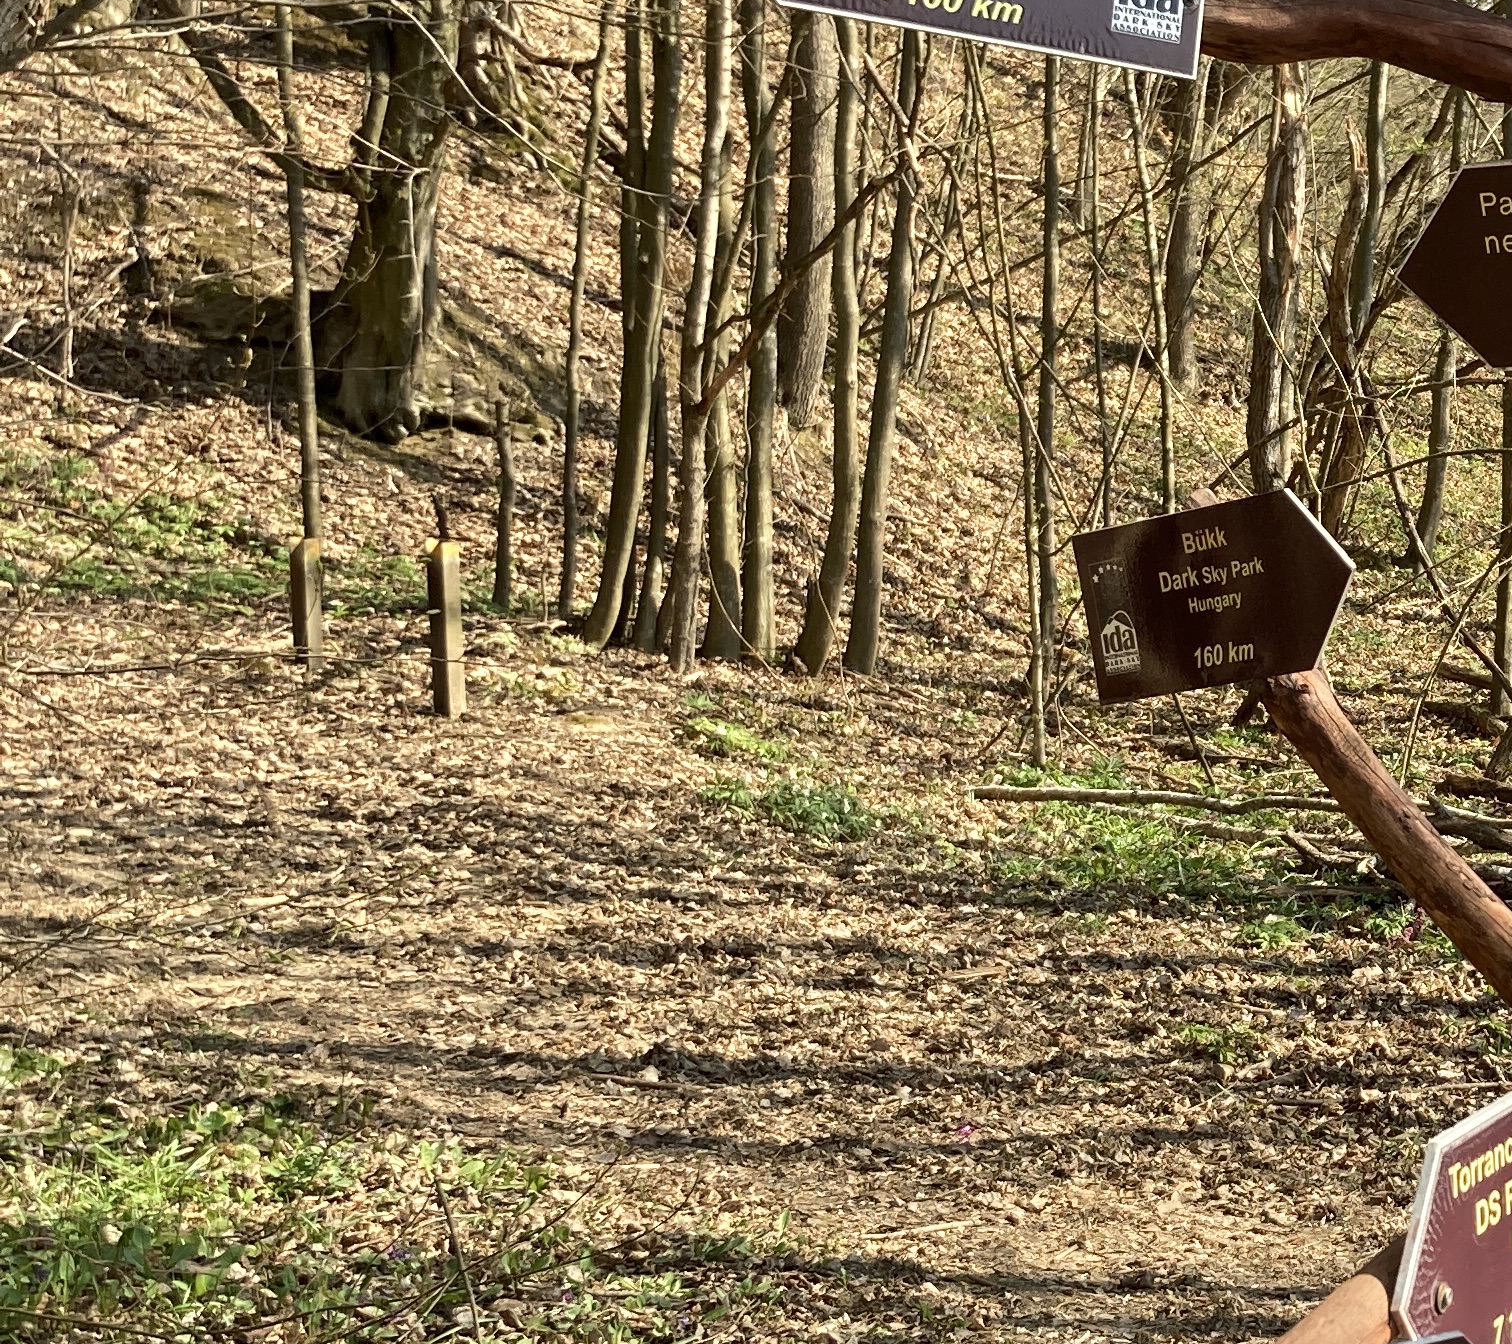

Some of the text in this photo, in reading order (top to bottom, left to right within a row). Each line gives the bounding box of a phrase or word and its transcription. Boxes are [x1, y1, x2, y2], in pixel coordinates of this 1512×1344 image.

[1114, 5, 1181, 24] INTERNATIONAL
[1113, 22, 1180, 42] ASSOCIATION
[1181, 526, 1228, 554] Bükk
[1159, 556, 1265, 593] Dark Sky Park
[1188, 592, 1242, 614] Hungary
[1194, 641, 1254, 669] 160 km
[1474, 1190, 1501, 1236] DS
